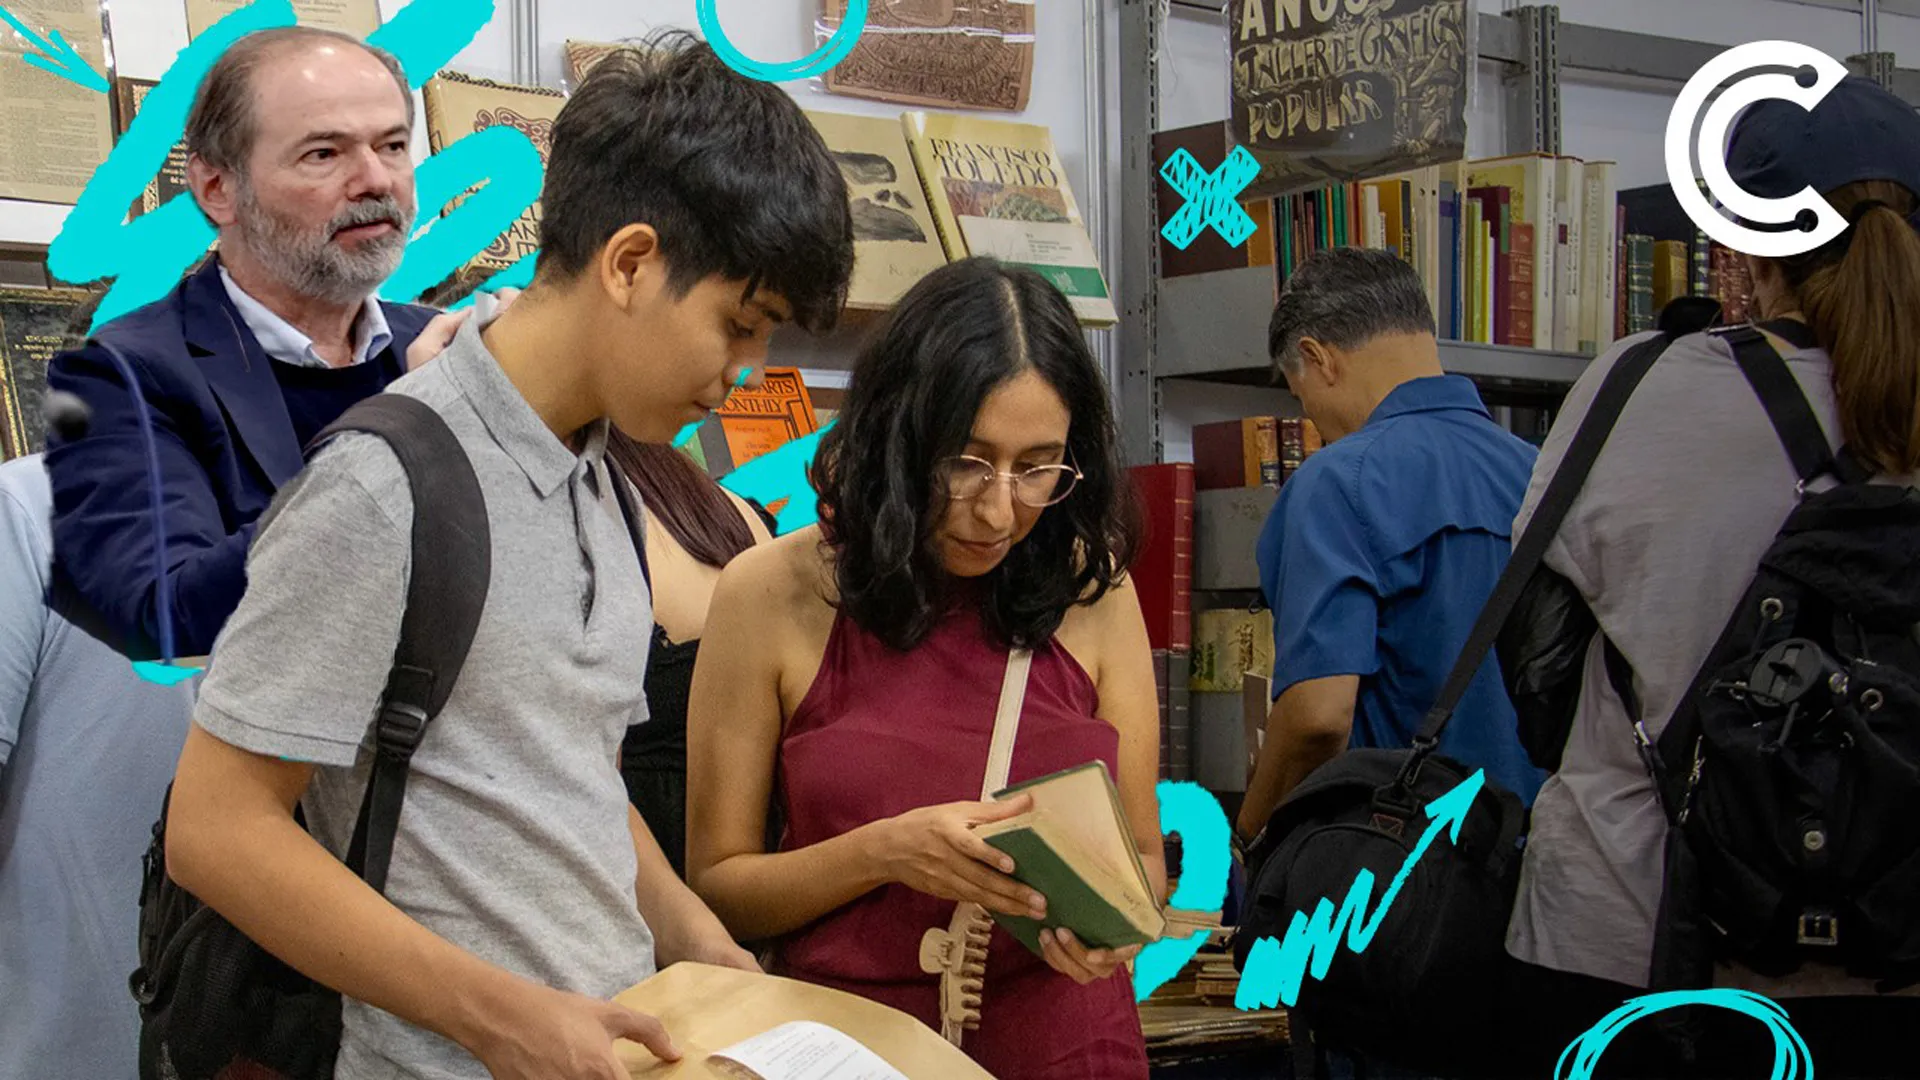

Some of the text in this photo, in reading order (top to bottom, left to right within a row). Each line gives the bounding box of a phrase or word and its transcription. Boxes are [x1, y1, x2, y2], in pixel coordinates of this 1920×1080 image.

[1248, 79, 1382, 144] POPULAR
[929, 138, 1051, 167] FRANCISCO
[932, 154, 1058, 187] TOLEDO
[722, 396, 782, 413] ONTHLY
